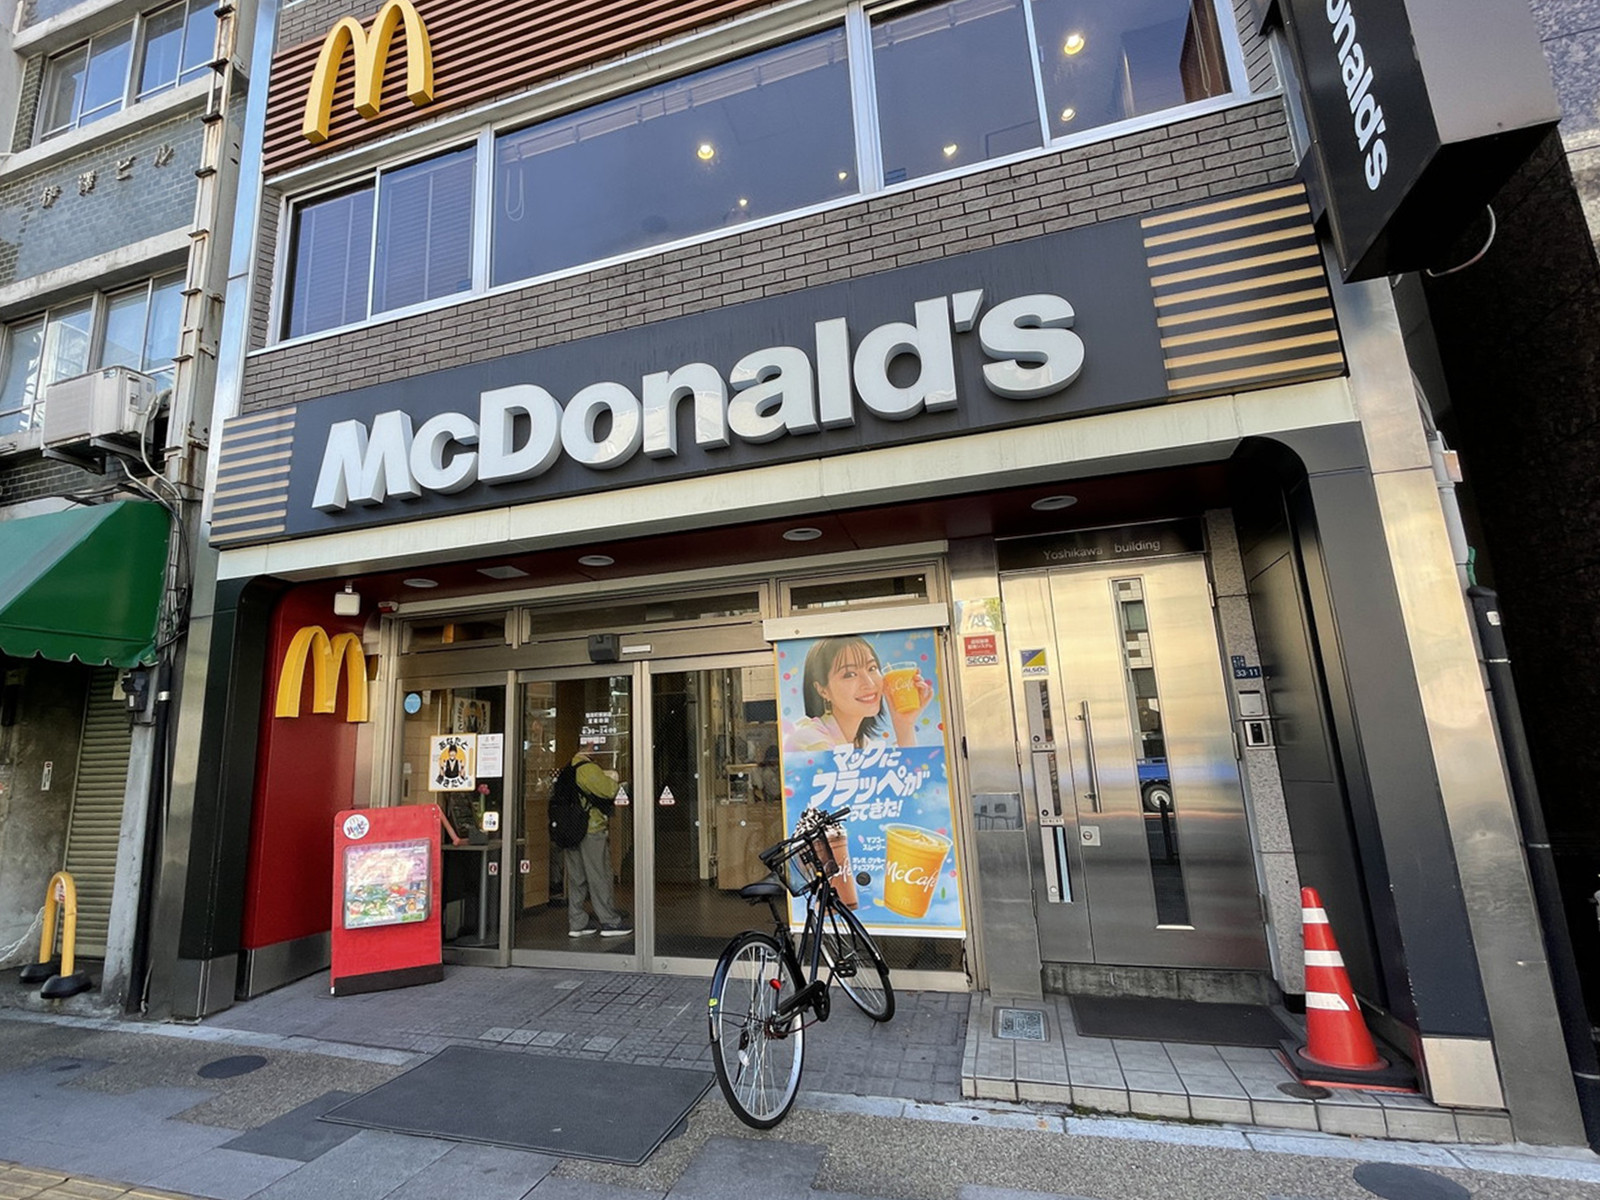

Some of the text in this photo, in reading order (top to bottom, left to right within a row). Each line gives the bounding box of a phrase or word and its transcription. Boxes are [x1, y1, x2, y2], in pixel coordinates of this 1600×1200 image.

[311, 288, 1085, 512] McDonald's
[1043, 540, 1161, 560] Yoshikawa building
[967, 655, 996, 665] SECOM
[833, 739, 902, 771] マックに
[808, 765, 930, 809] フラッペが
[841, 798, 904, 822] ってきた!
